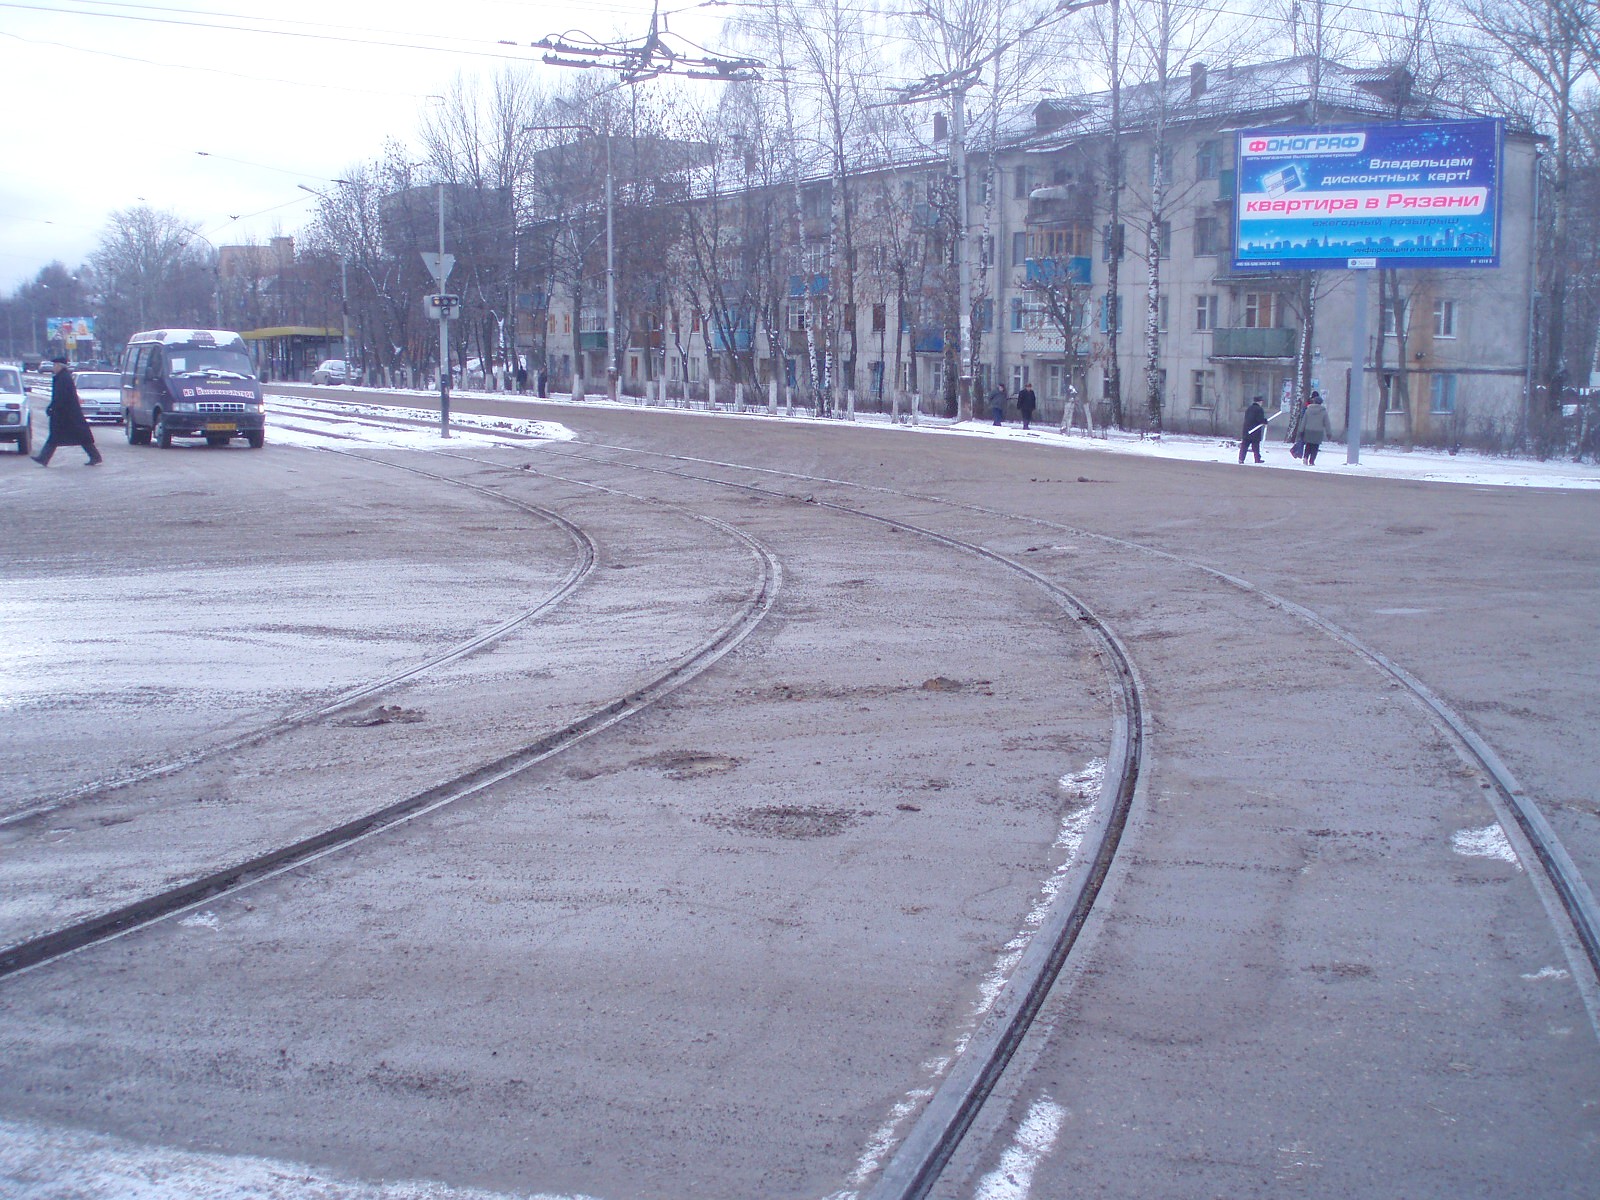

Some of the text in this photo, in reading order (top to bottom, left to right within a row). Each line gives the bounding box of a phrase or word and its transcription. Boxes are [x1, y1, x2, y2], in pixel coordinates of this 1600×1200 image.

[1249, 137, 1359, 152] ФОНОГРАФ
[1369, 158, 1473, 169] Владельцам
[1321, 170, 1471, 185] дисконтных карт!
[1246, 193, 1479, 215] квартира в Рязани
[1312, 216, 1459, 228] ежегодный розыгрыш
[1353, 246, 1409, 255] информация
